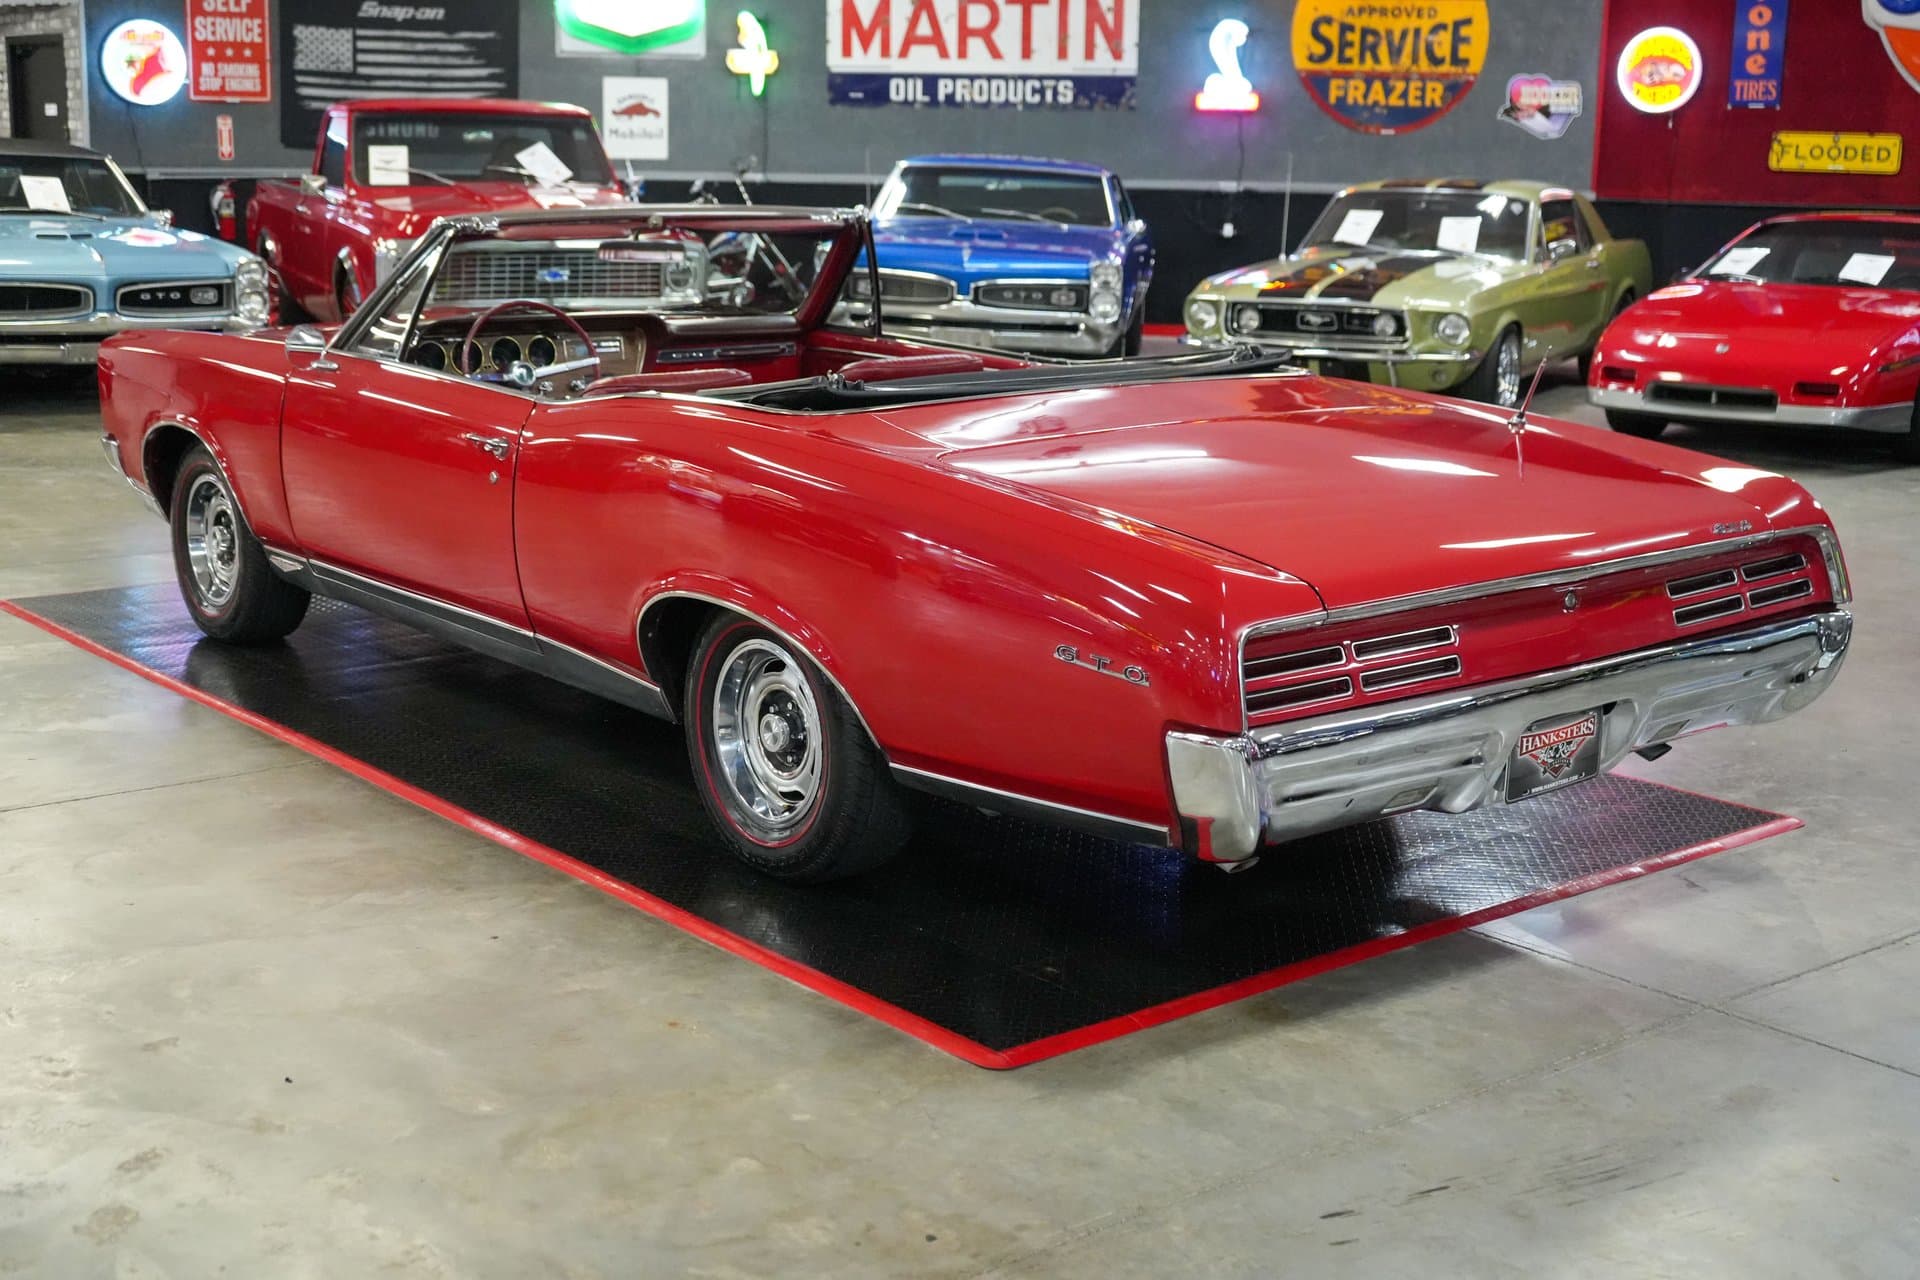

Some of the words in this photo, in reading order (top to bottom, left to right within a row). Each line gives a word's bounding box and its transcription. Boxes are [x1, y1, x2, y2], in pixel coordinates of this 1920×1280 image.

[357, 0, 445, 21] Snap-on
[1346, 5, 1438, 19] APPROVED
[195, 16, 262, 43] SERVICE
[840, 0, 1125, 61] MARTIN
[1307, 15, 1473, 68] SERVICE
[889, 77, 930, 103] OIL
[938, 78, 1074, 104] PRODUCTS
[1328, 79, 1446, 108] FRAZER
[1734, 79, 1778, 101] TIRES
[1780, 143, 1892, 163] FLOODED
[140, 291, 181, 301] GTO
[1054, 644, 1150, 687] GTO
[1521, 718, 1594, 754] HANKSTERS
